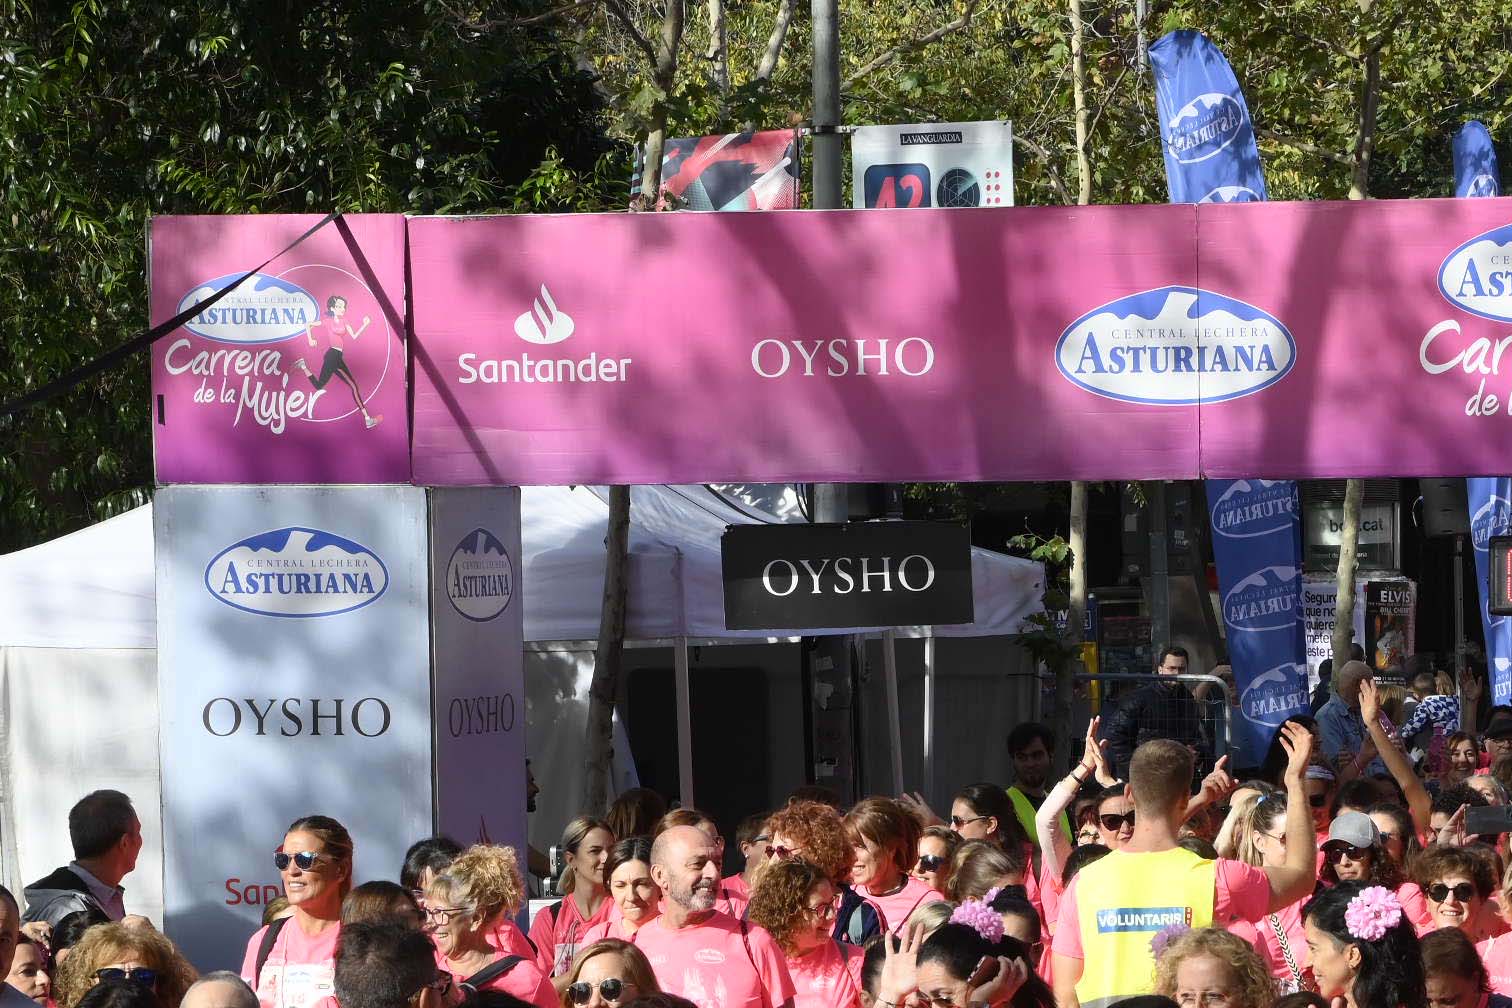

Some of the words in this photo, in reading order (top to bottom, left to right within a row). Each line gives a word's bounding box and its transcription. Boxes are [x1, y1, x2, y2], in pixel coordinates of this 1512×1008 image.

[1110, 326, 1188, 339] CENTRAL
[1192, 326, 1269, 339] LECHERA
[164, 339, 282, 376] Carrera
[458, 352, 632, 384] Santander
[750, 336, 935, 378] OYSHO
[1074, 332, 1279, 374] ASTURIANA
[194, 380, 216, 404] de
[220, 378, 236, 404] la
[233, 371, 327, 434] Mujer
[1465, 379, 1495, 417] de
[220, 560, 376, 594] ASTURIANA
[247, 559, 304, 568] CENTRAL
[310, 559, 369, 568] LECHERA
[451, 561, 510, 599] ASTURIANA
[762, 554, 935, 597] OYSHO
[1380, 590, 1411, 603] ELVIS
[202, 697, 391, 737] OYSHO
[449, 692, 514, 738] OYSHO
